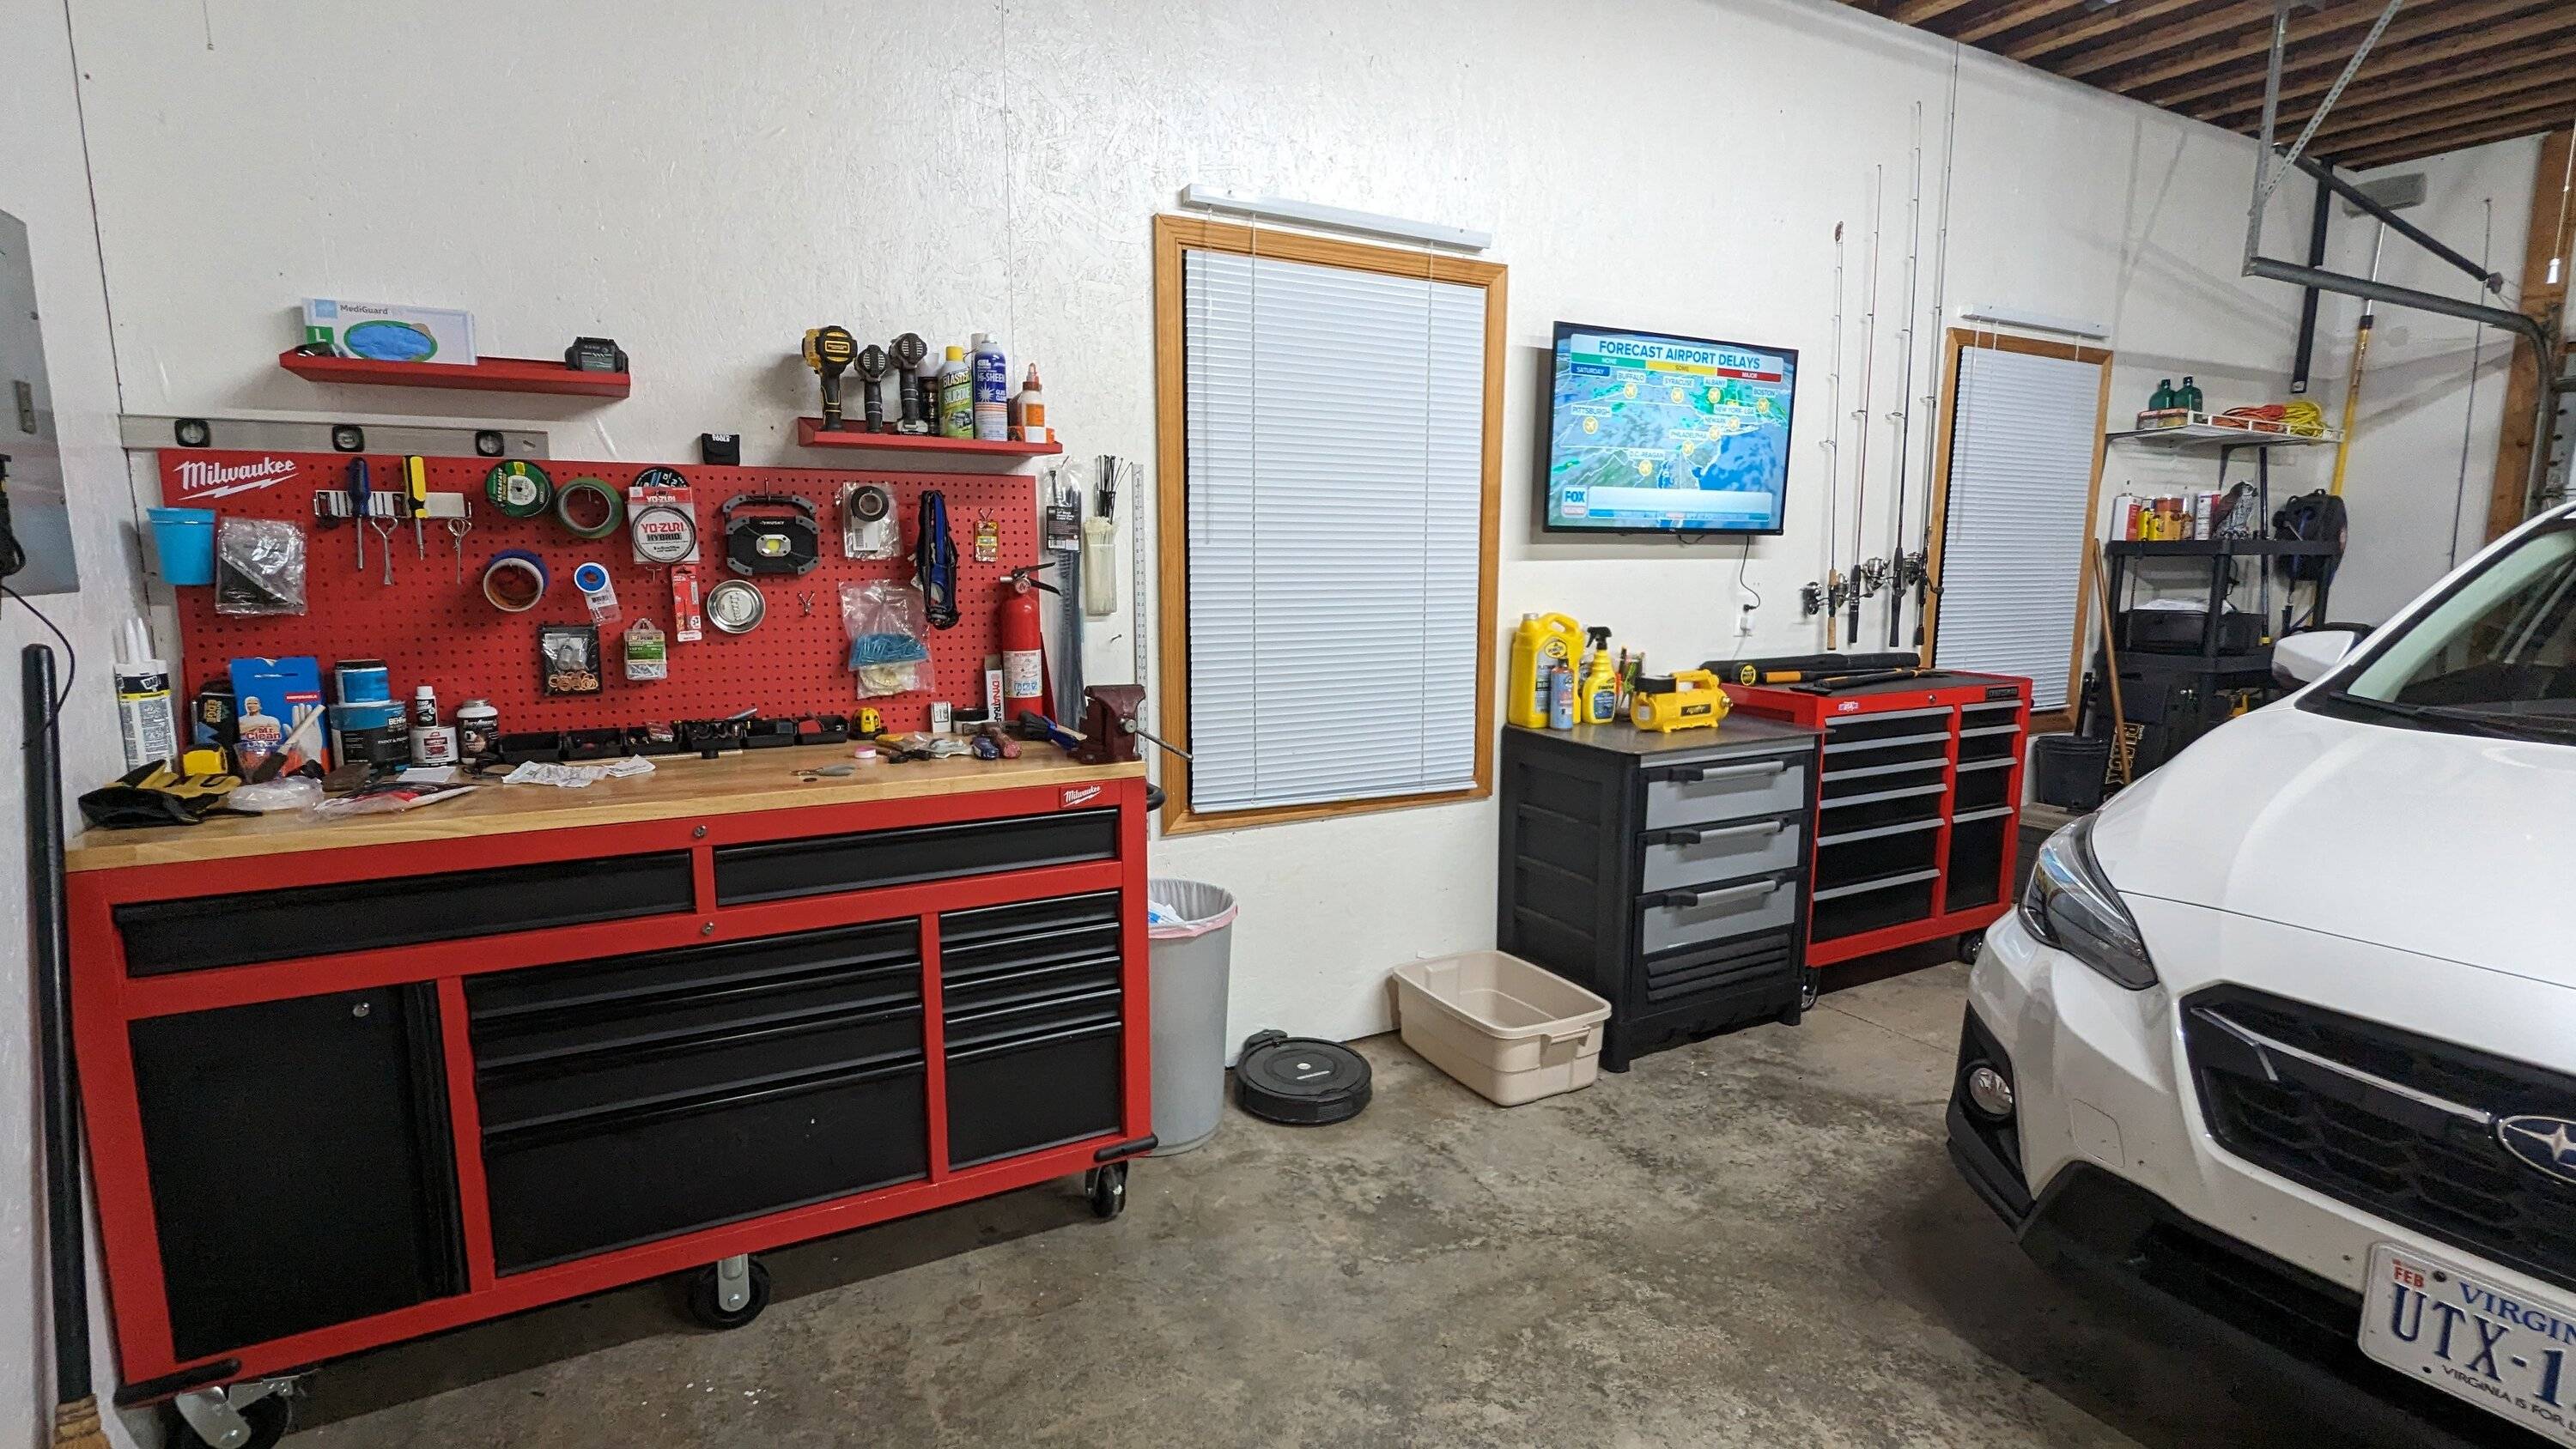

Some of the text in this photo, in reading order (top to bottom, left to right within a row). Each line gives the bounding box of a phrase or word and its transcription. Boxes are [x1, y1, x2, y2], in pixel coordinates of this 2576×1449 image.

[340, 304, 389, 315] MediGuard
[315, 328, 326, 343] L
[1599, 341, 1760, 369] FORECAST AIRPORT DELAYS
[1577, 367, 1604, 375] SATURDAY
[1618, 373, 1644, 381] BUFFALO
[943, 370, 970, 387] BLASTER
[1664, 378, 1692, 386] SYRACUSE
[1705, 378, 1726, 386] ALBANY
[1753, 388, 1775, 397] BOSTON
[173, 457, 296, 490] Milwaukee
[1564, 490, 1585, 503] FOX
[641, 522, 684, 533] YO-ZURI
[647, 532, 681, 542] HYBRID
[1064, 785, 1101, 803] Milwaukee
[2394, 1266, 2424, 1287] FEB
[2392, 1284, 2576, 1412] UTX-1
[2442, 1364, 2512, 1403] VIRGINIA
[2515, 1397, 2527, 1410] IS
[2531, 1404, 2567, 1428] FOR
